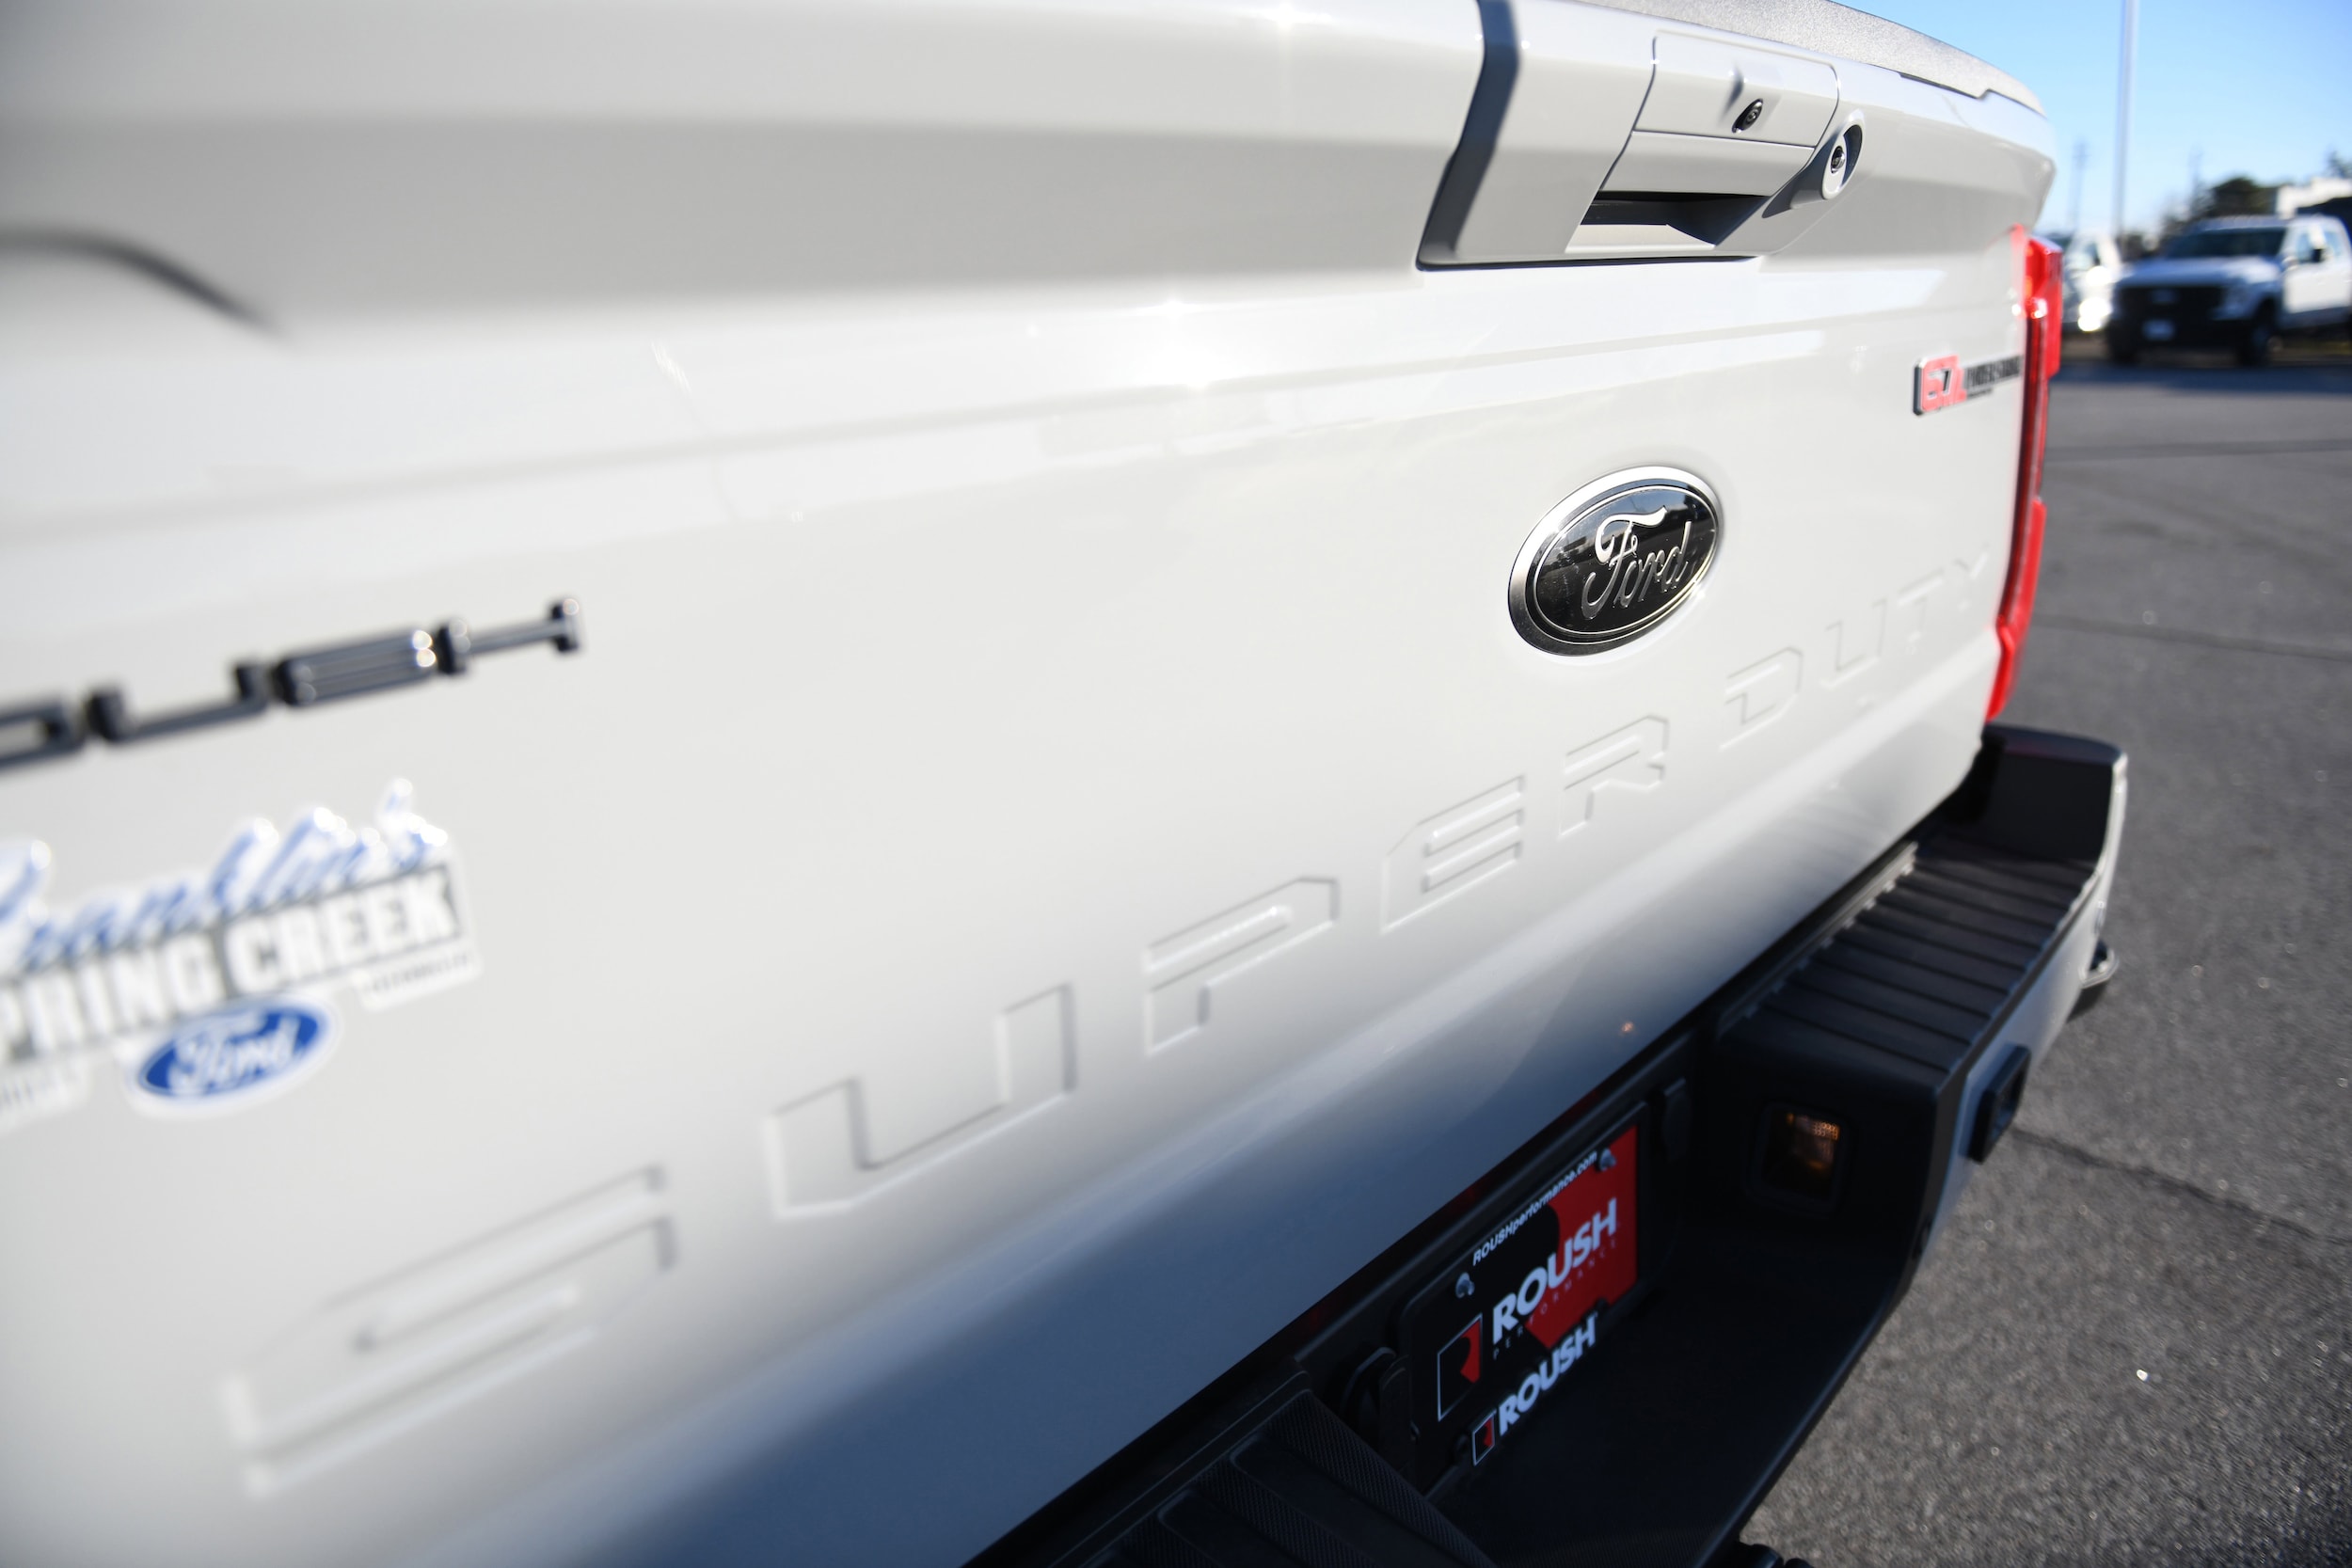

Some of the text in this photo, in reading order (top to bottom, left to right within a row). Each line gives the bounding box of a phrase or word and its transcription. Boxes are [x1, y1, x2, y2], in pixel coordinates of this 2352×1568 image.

[1581, 505, 1692, 619] Ford
[224, 865, 460, 995] CREEK
[169, 1008, 300, 1096] Ford
[222, 543, 1991, 1497] SUPER DUTY
[1472, 1150, 1597, 1265] ROUSHperformance.com
[1492, 1197, 1616, 1345] ROUSH
[1492, 1238, 1616, 1360] PERFORMANCE
[1498, 1314, 1597, 1436] ROUSH
